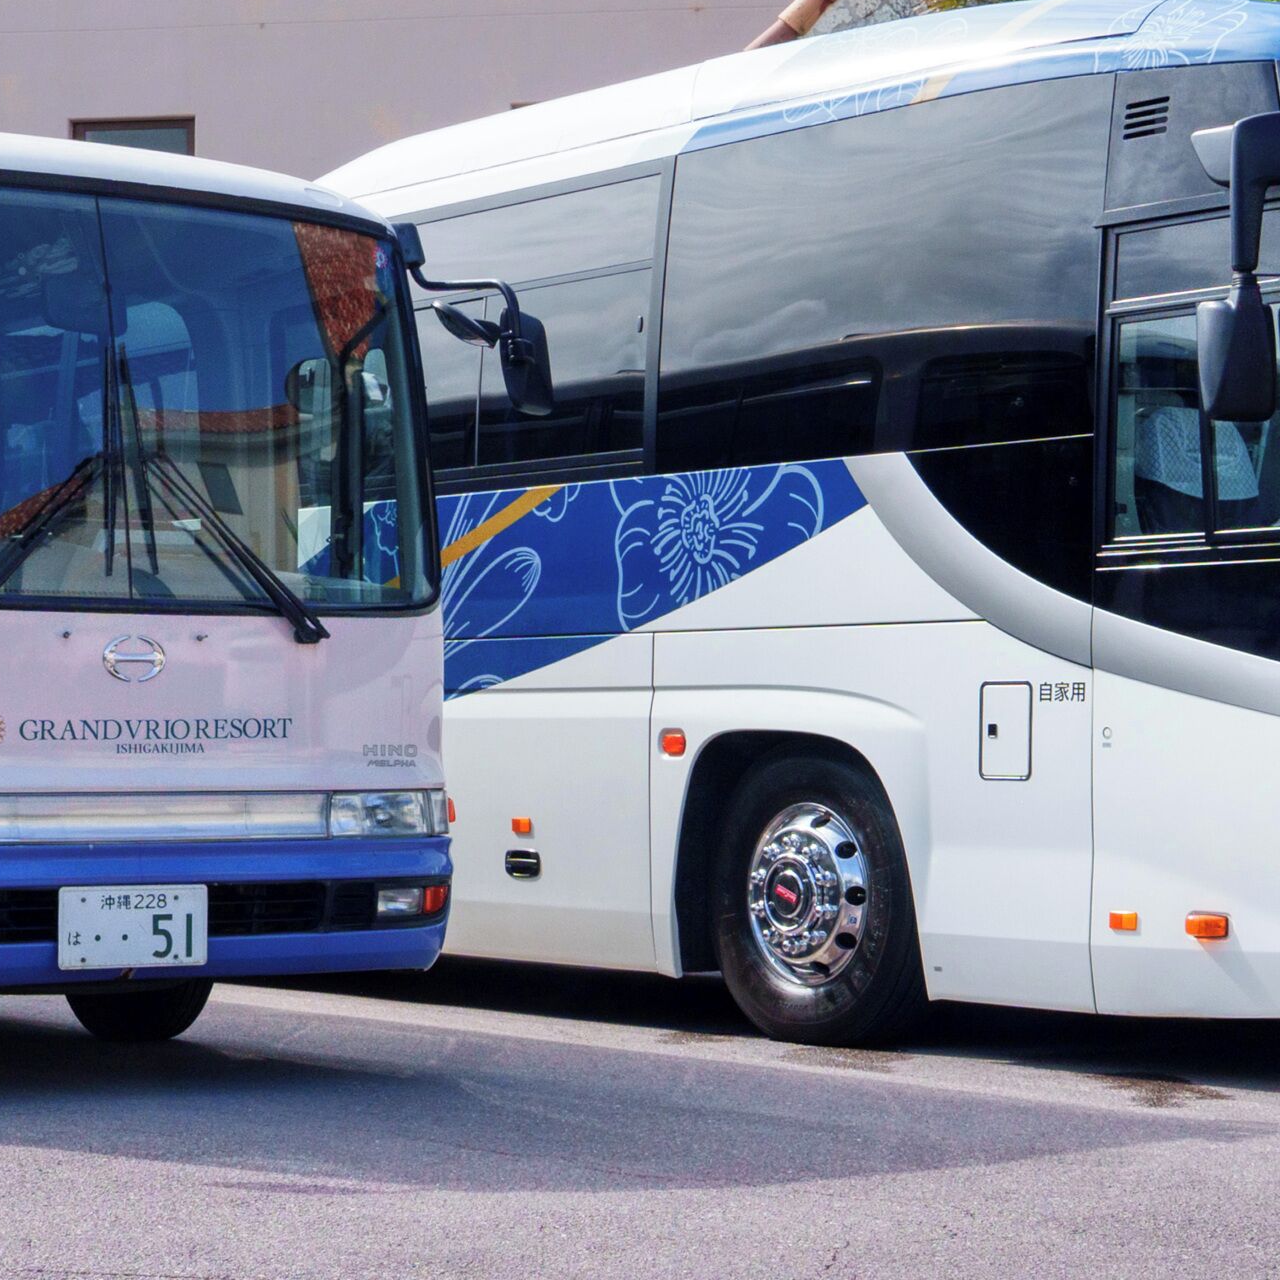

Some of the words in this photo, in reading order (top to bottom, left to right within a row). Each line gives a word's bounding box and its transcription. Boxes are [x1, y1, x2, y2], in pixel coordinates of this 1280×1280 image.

[1039, 681, 1087, 703] 自家用
[116, 742, 206, 756] ISHIGAKIJIMA
[362, 743, 419, 758] HINO
[67, 931, 82, 946] は
